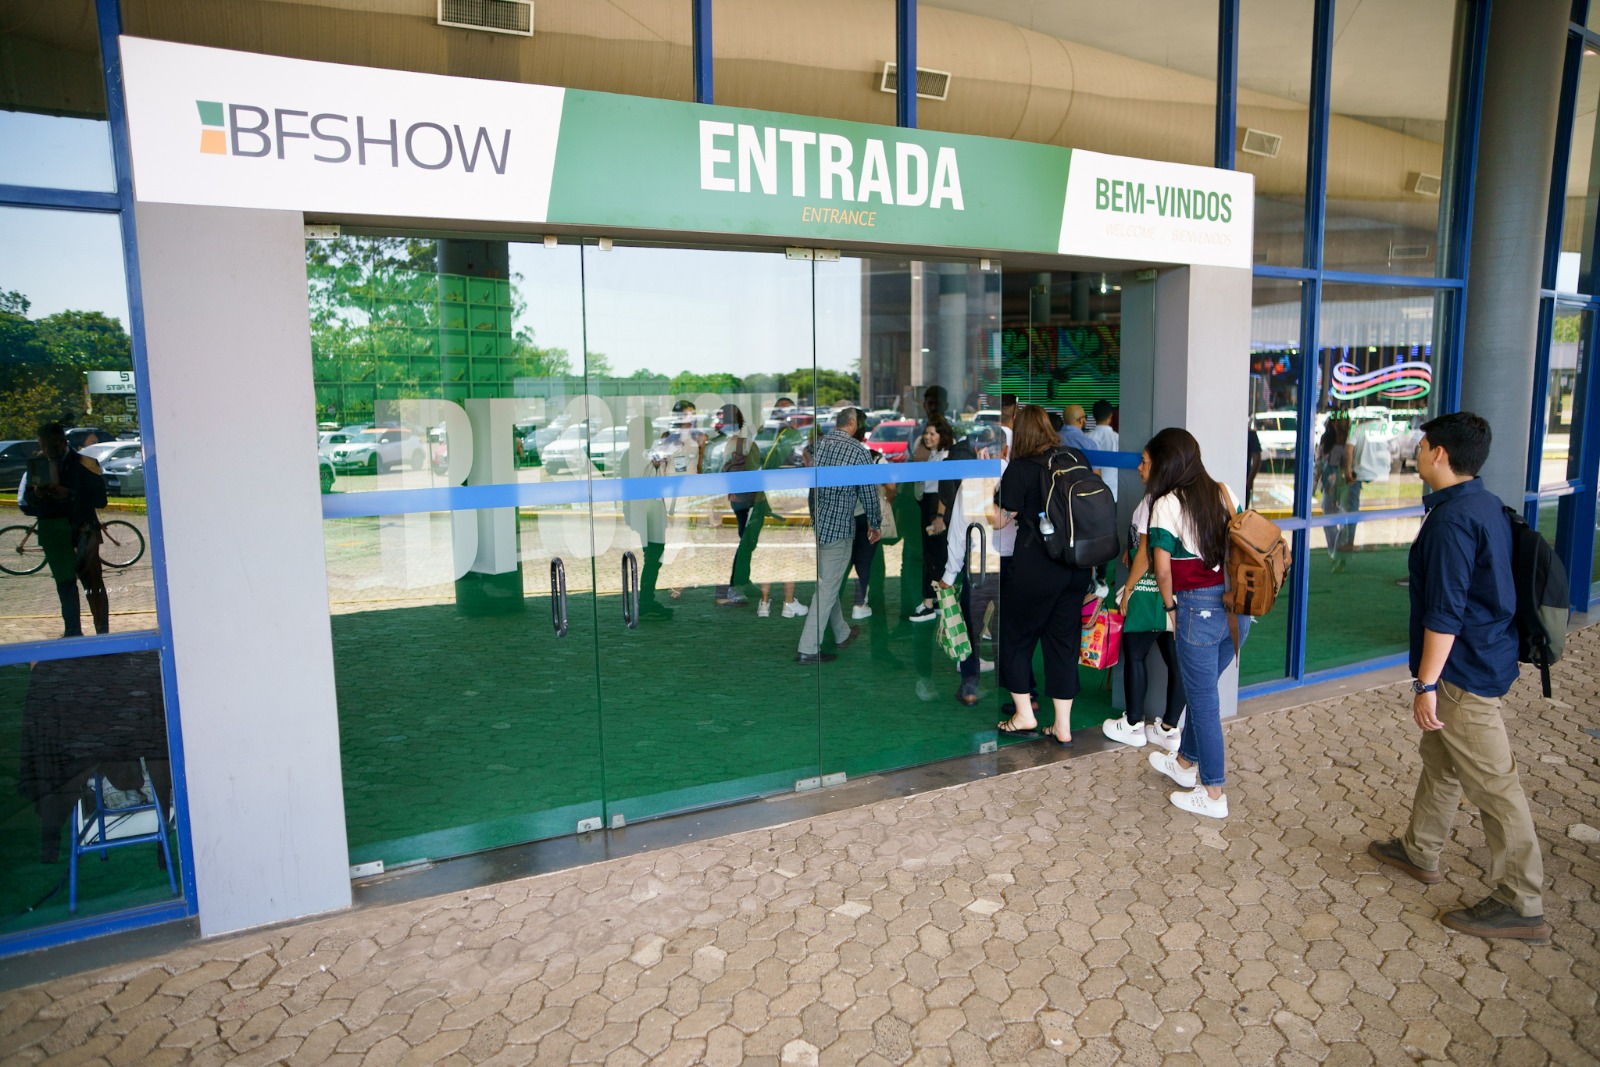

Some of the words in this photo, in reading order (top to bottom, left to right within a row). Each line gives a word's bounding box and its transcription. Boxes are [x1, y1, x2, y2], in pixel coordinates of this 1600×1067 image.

[228, 103, 511, 175] BFSHOW
[699, 119, 965, 211] ENTRADA
[802, 206, 877, 227] ENTRANCE
[1096, 177, 1232, 223] BEM-VINDOS
[1105, 223, 1156, 240] WELCOME
